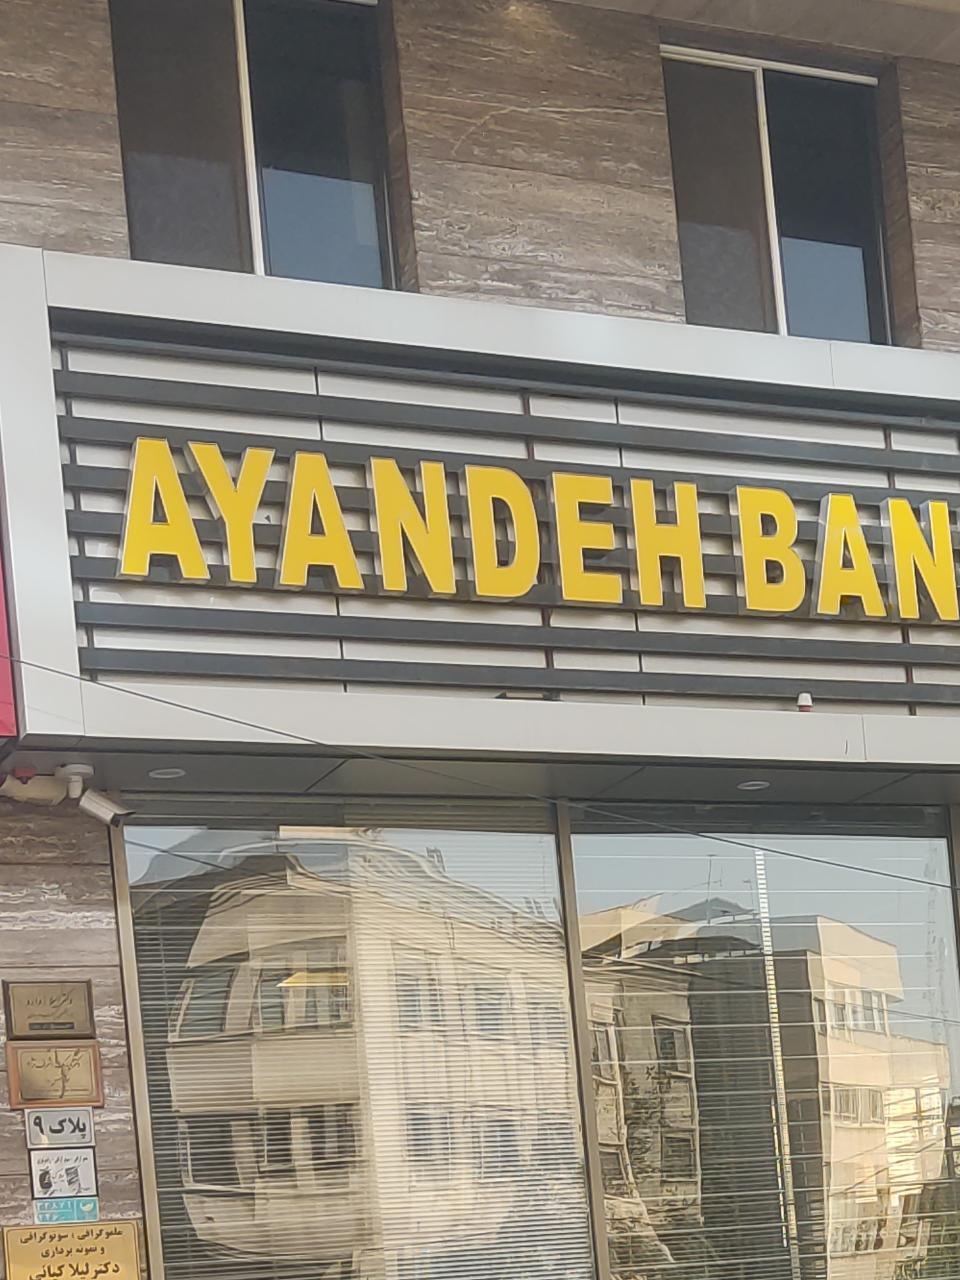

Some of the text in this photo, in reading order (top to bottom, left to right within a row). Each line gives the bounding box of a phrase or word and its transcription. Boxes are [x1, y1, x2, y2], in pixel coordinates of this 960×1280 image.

[119, 437, 706, 609] AYANDEH
[33, 1115, 87, 1140] پلاک ۹
[20, 1230, 69, 1244] سونوگرافی
[41, 1246, 73, 1258] برداری
[69, 1261, 90, 1280] لیلا
[91, 1261, 120, 1280] دکتر
